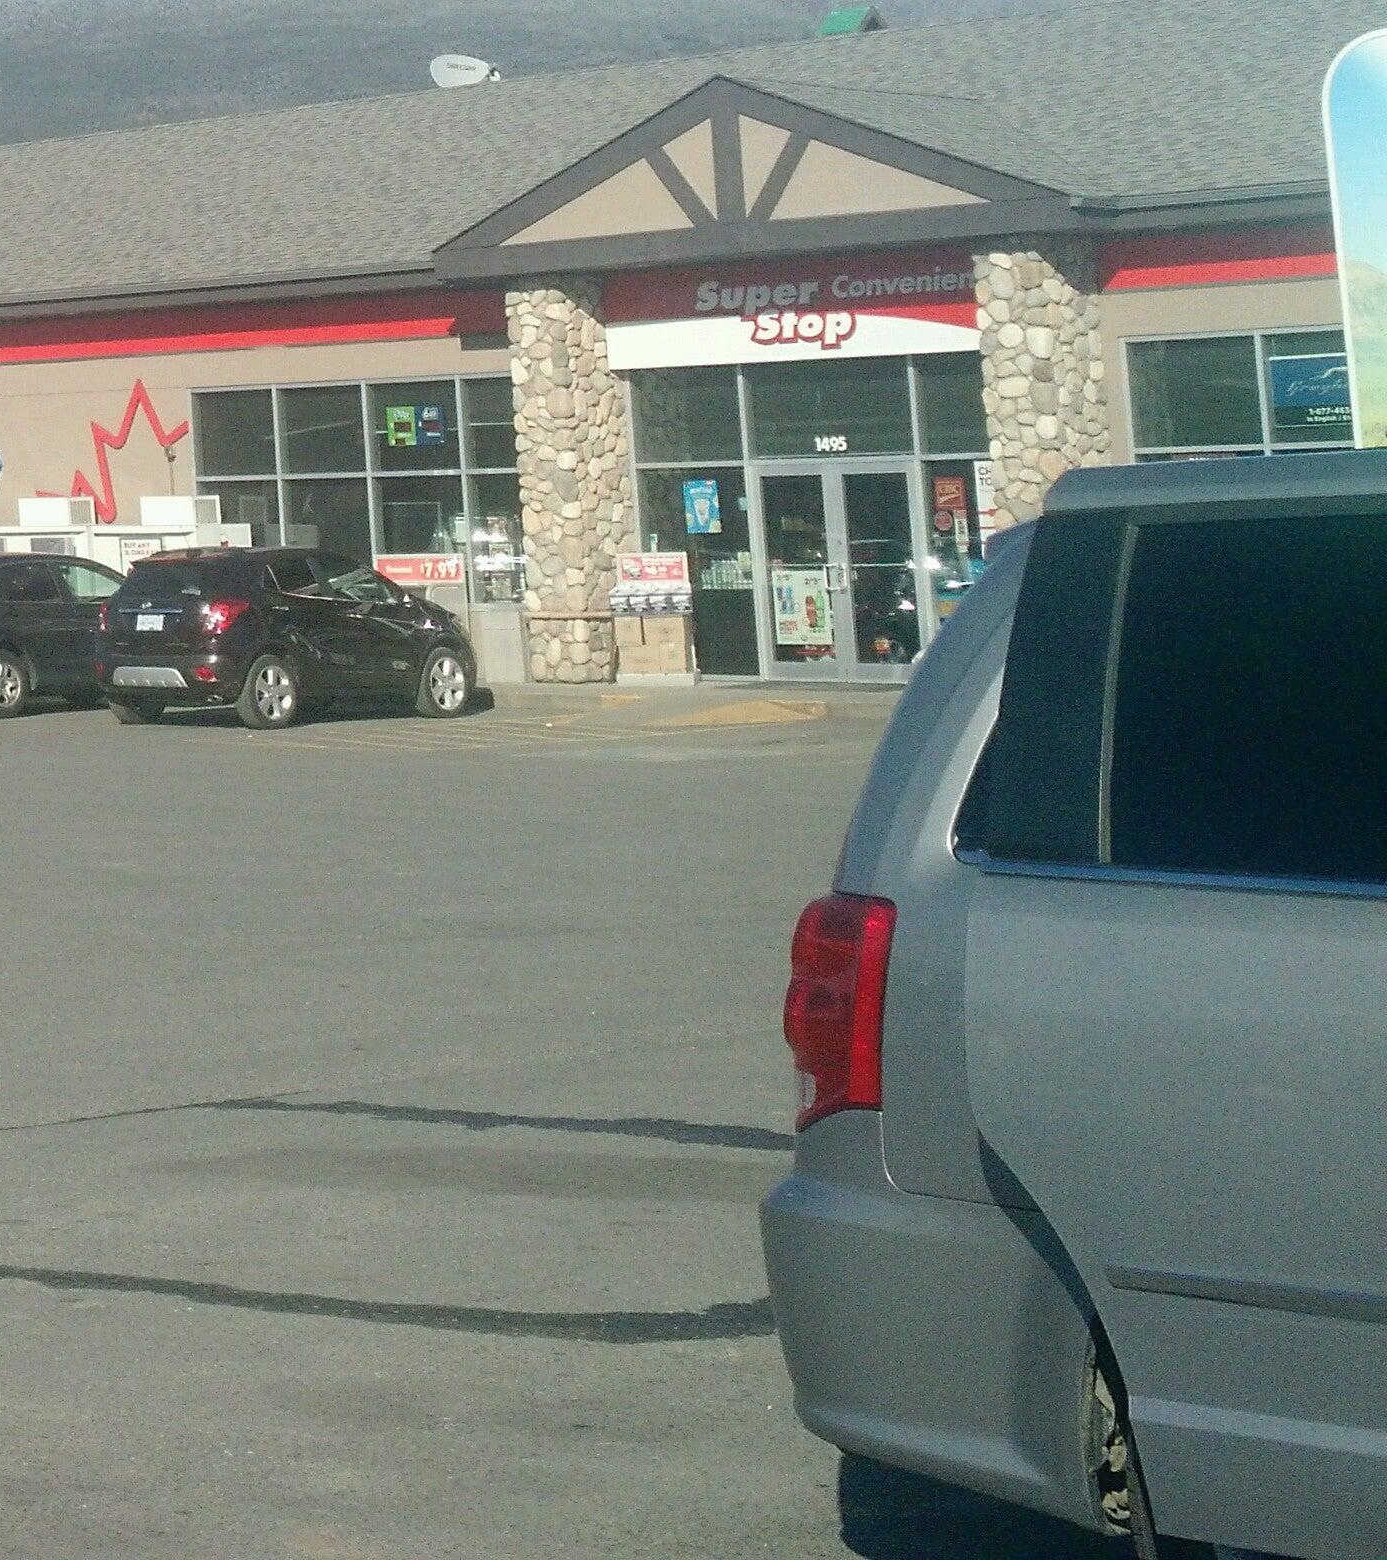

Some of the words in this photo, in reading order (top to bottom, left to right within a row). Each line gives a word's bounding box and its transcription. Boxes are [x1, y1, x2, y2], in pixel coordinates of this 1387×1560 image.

[695, 280, 818, 315] Super
[752, 310, 857, 349] Stop
[815, 436, 847, 451] 1495
